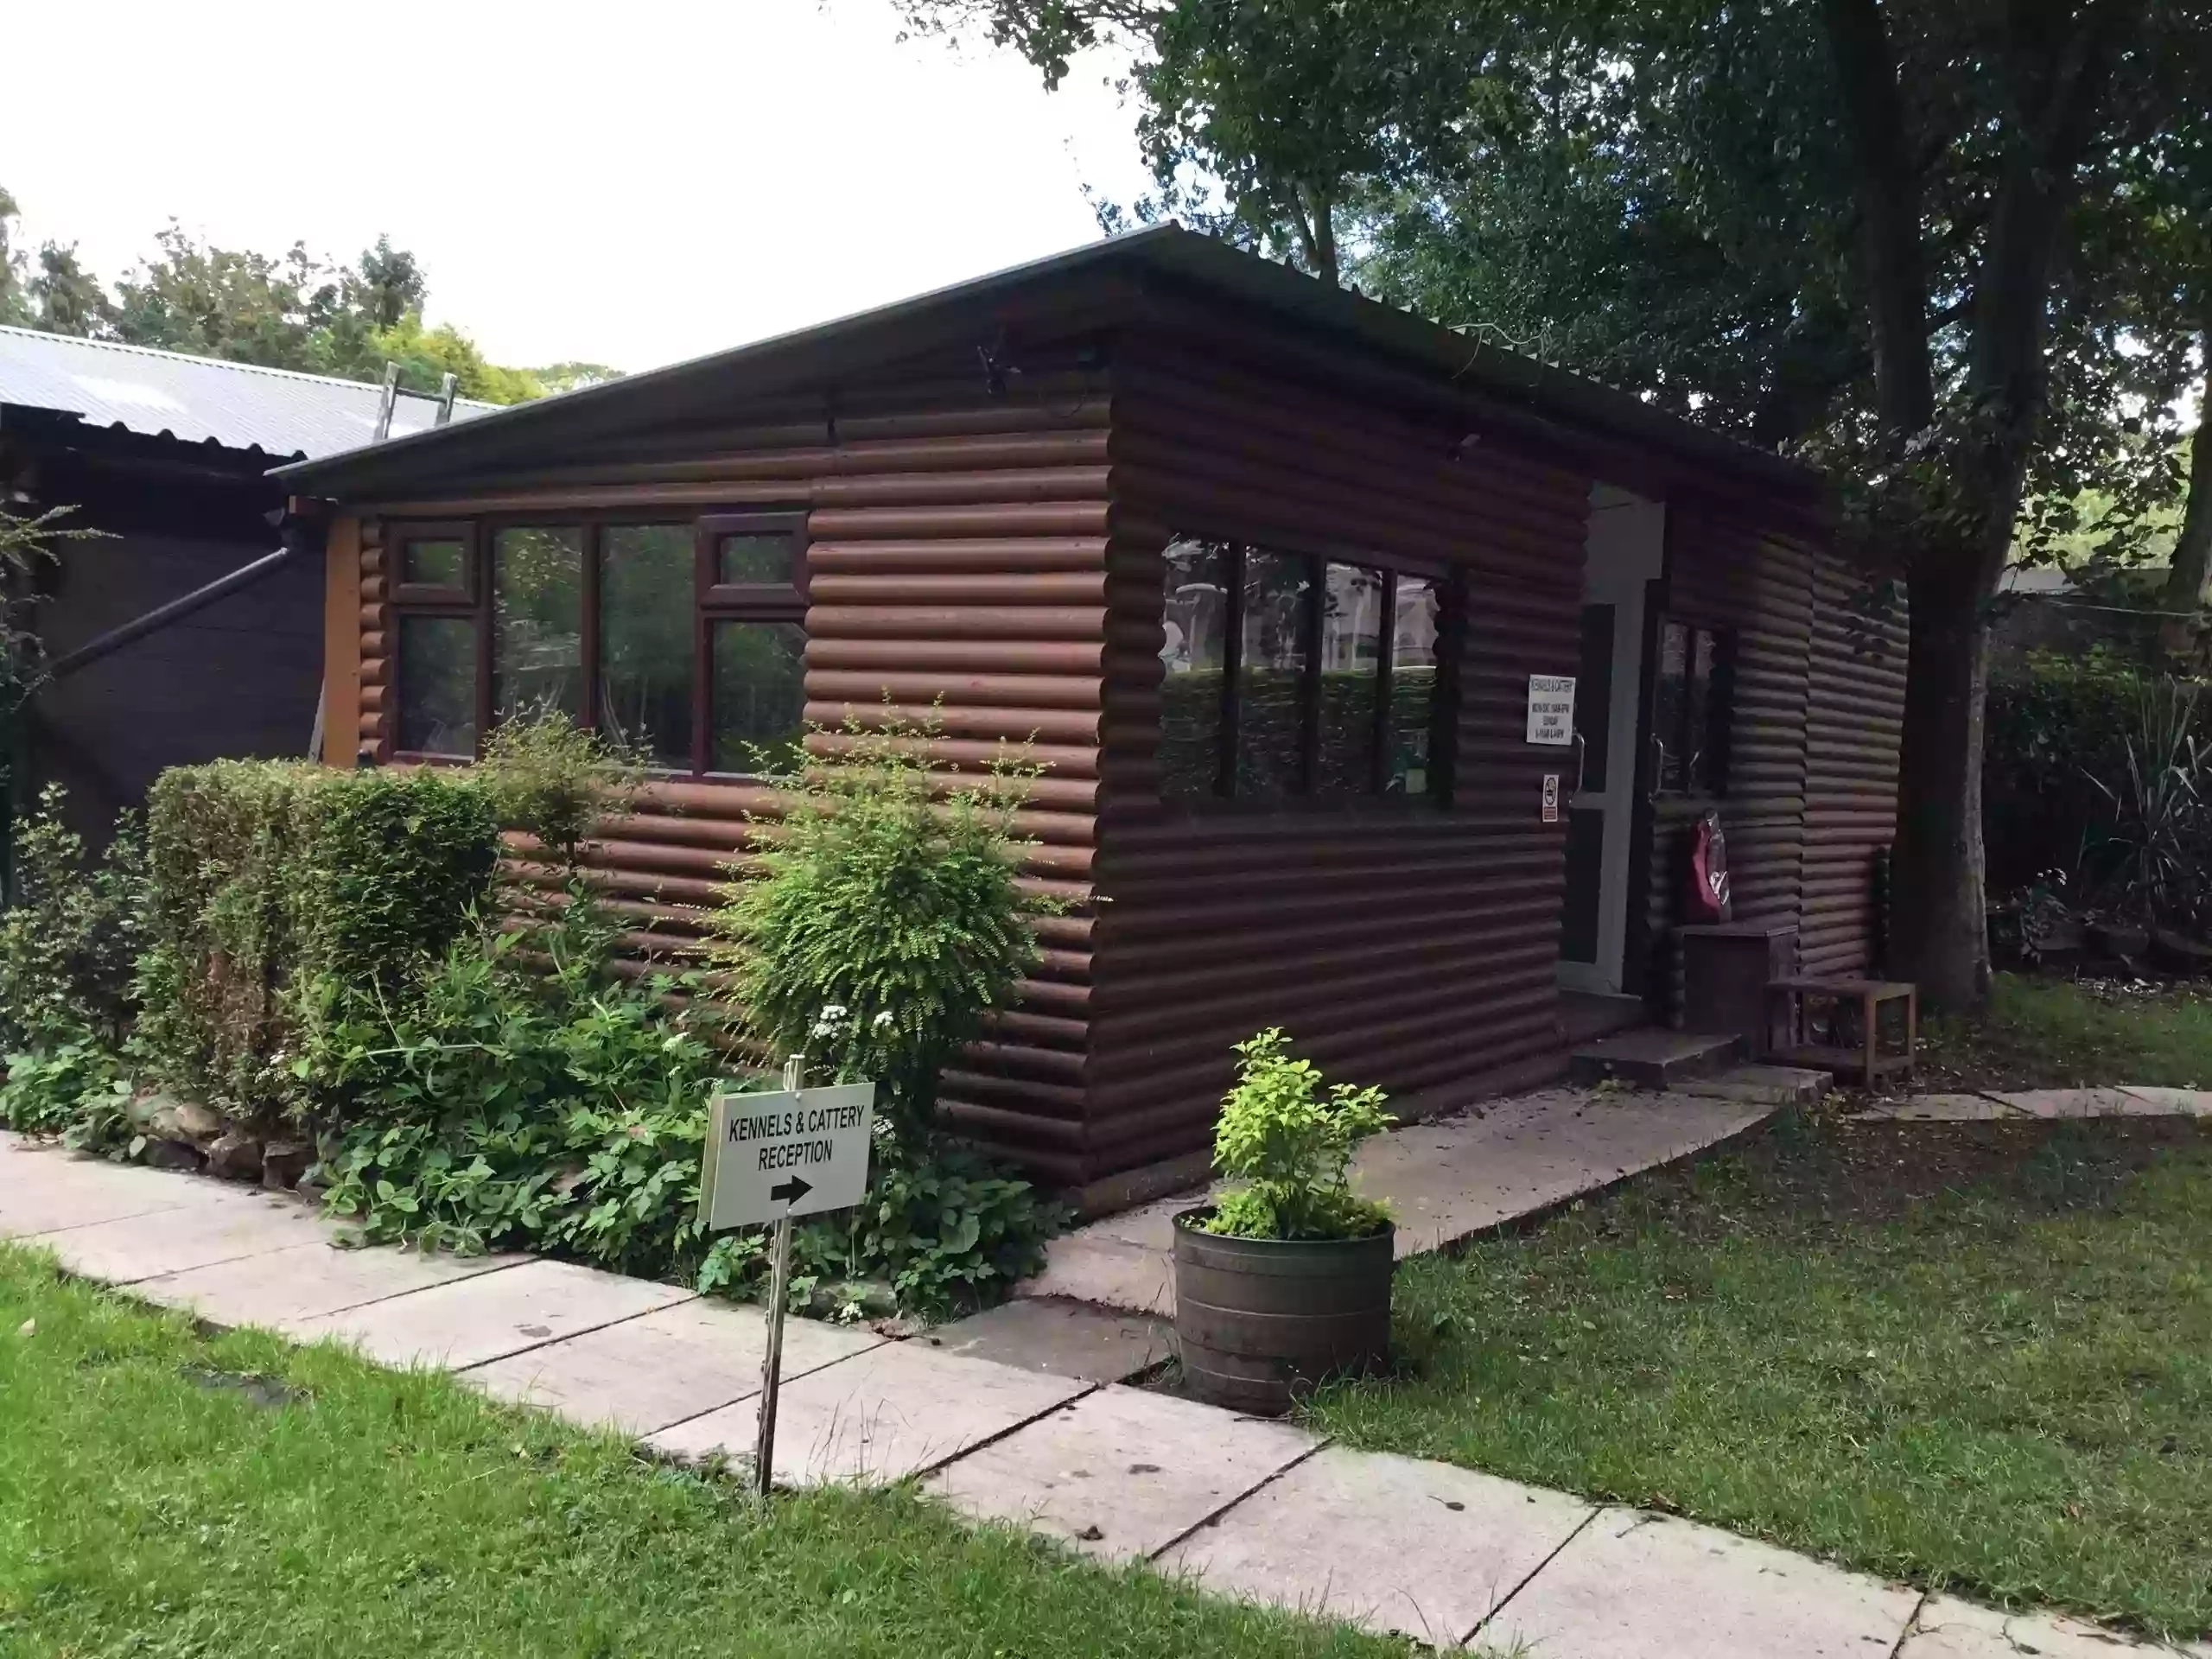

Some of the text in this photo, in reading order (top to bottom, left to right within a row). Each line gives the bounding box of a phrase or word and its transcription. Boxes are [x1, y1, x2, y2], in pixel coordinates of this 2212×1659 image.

[729, 1105, 864, 1141] KENNELS & CATTERY
[758, 1139, 833, 1171] RECEPTION
